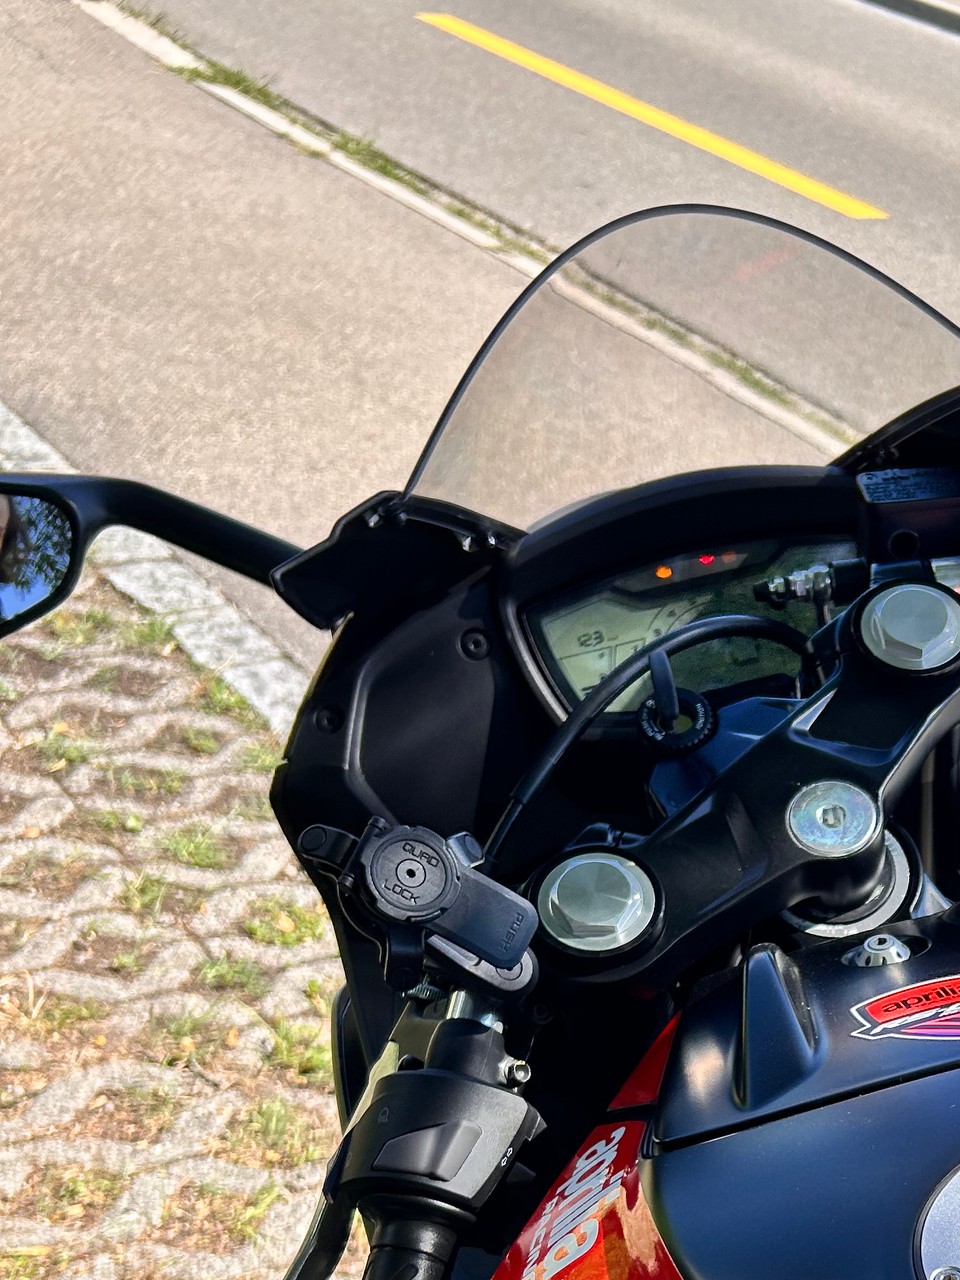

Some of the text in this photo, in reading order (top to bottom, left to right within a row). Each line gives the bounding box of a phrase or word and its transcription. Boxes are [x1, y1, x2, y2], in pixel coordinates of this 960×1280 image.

[401, 842, 440, 868] QUAD
[383, 879, 420, 905] LOCK
[501, 912, 525, 952] PUSH
